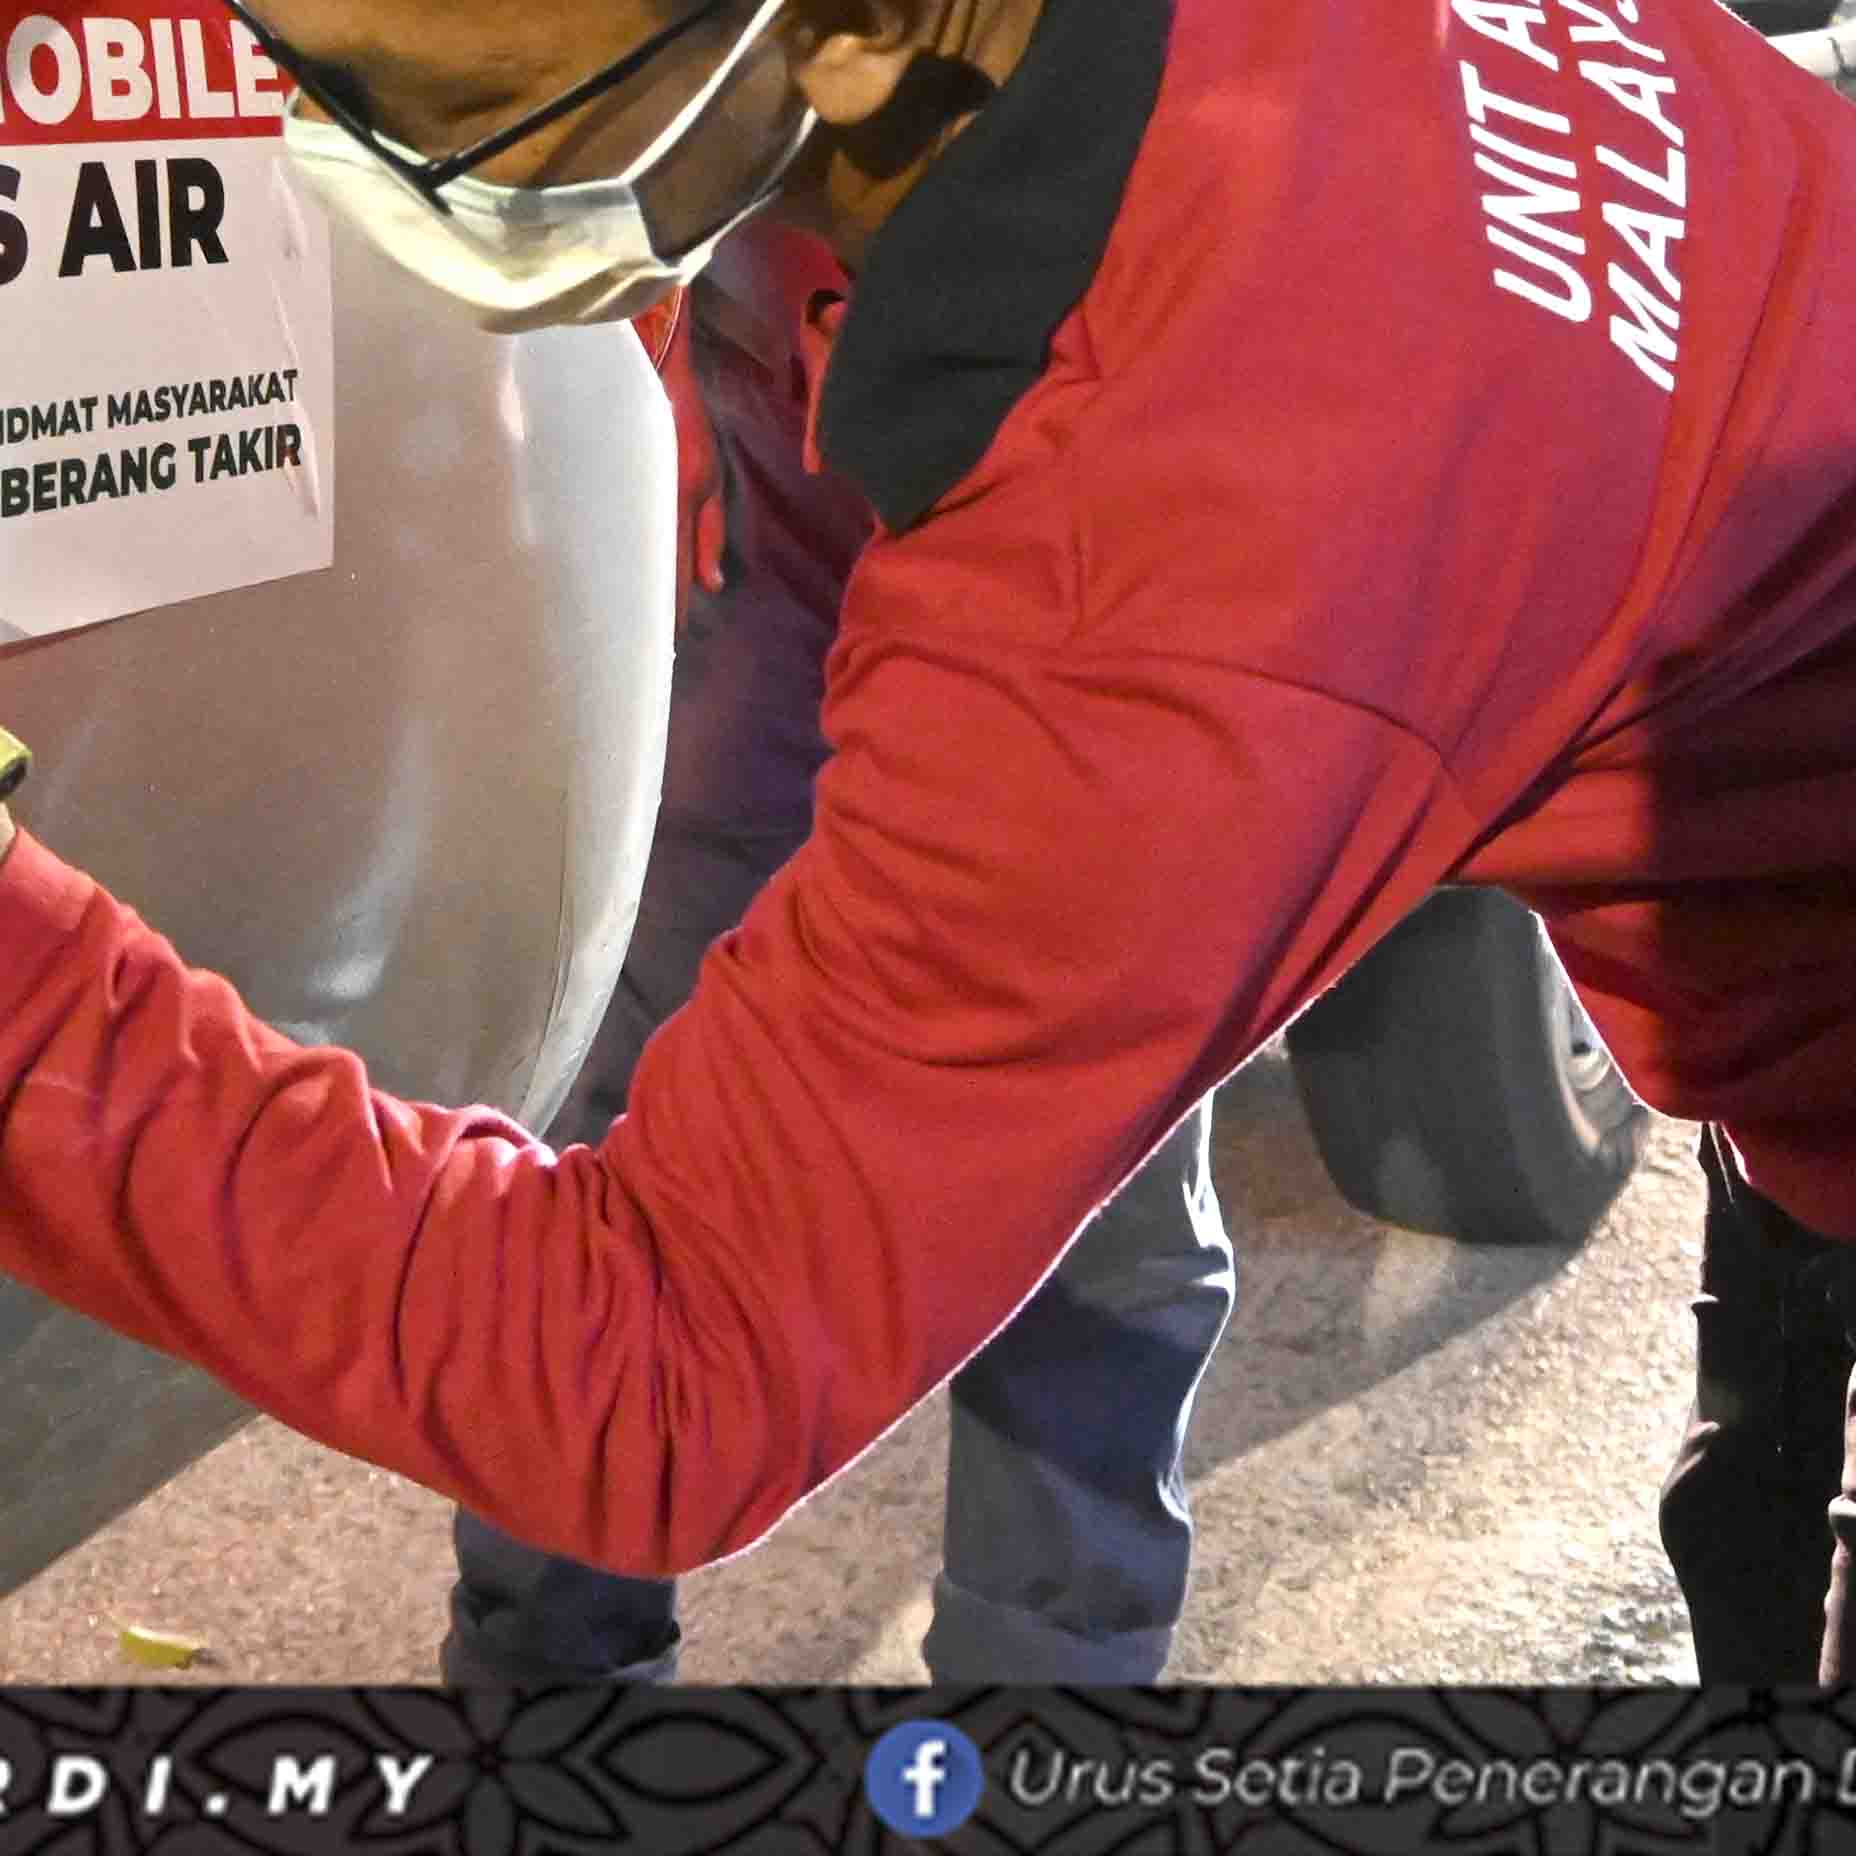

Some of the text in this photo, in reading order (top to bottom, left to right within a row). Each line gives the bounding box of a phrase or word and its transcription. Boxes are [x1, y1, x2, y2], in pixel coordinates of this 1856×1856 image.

[58, 156, 228, 280] AIR
[1458, 60, 1592, 322] UNIT
[106, 369, 298, 428] MASYARAKAT
[187, 423, 302, 483] TAKIR
